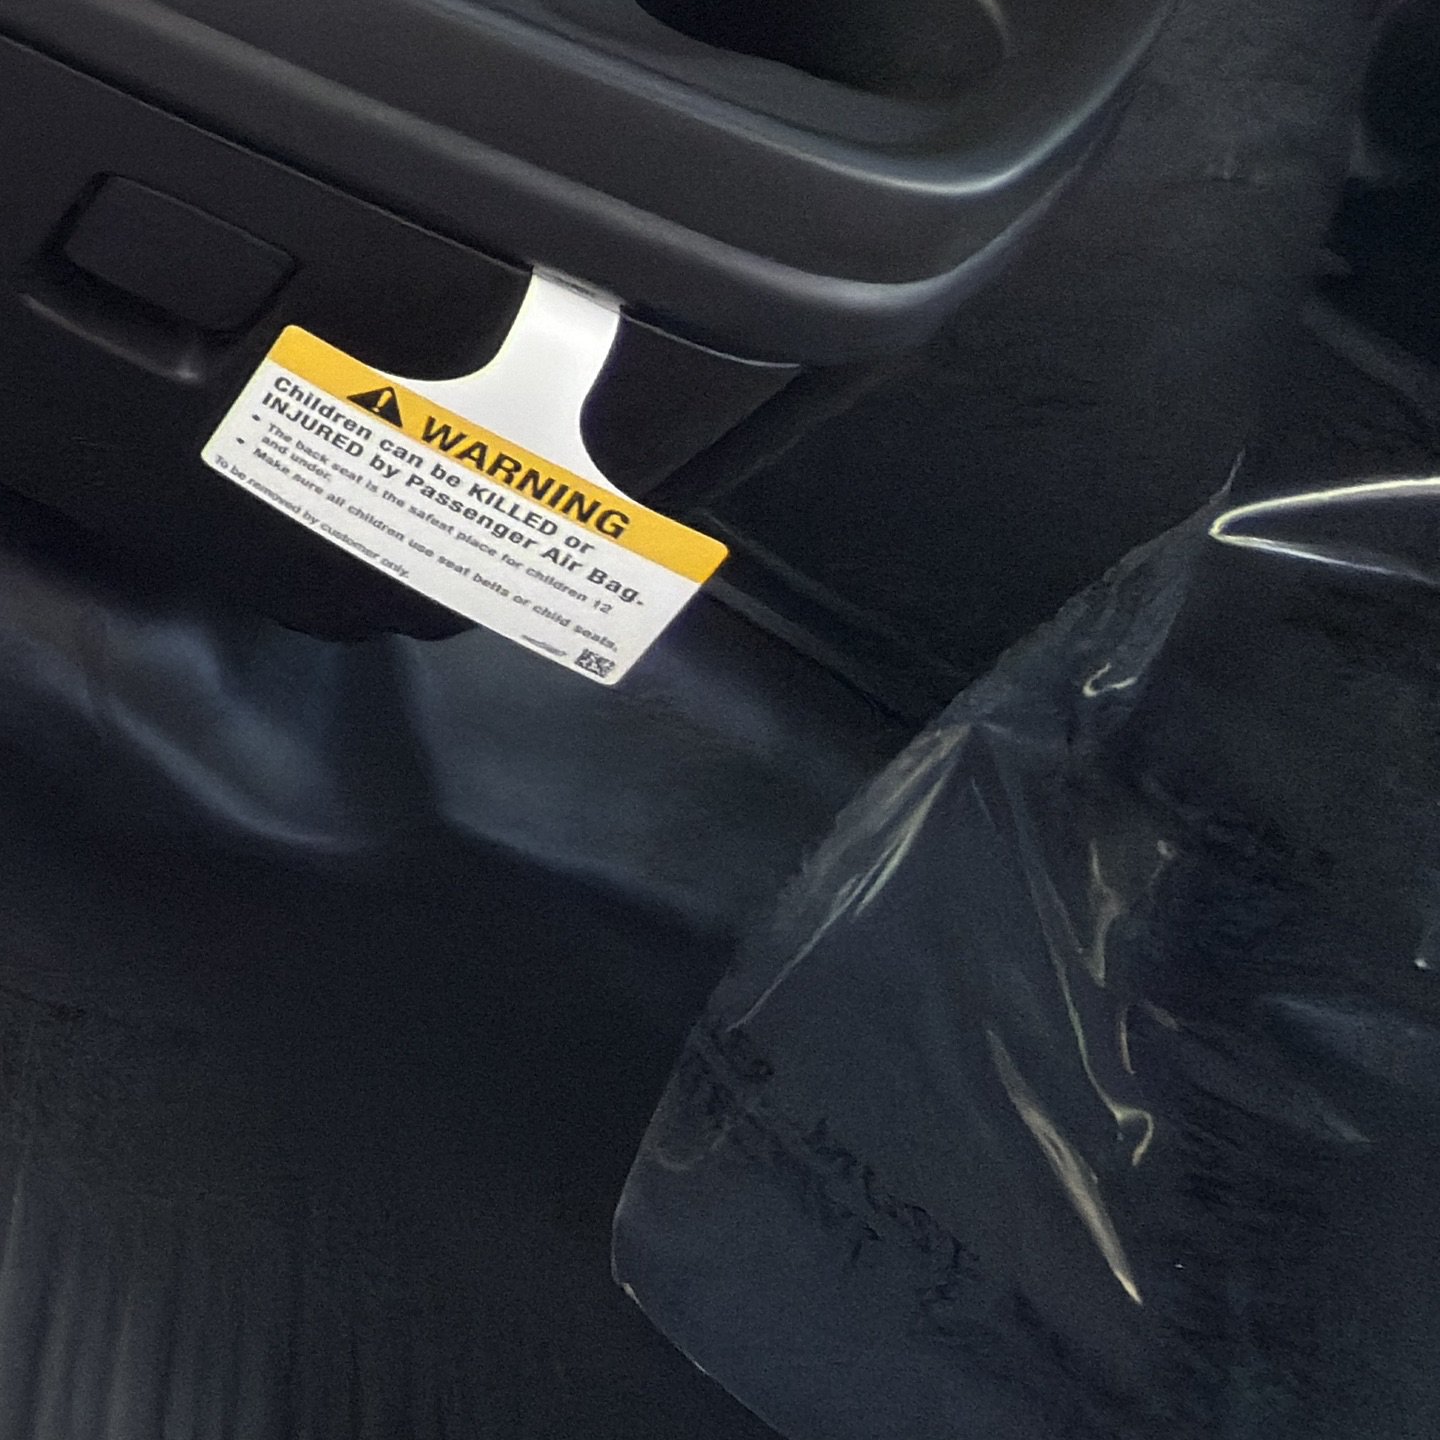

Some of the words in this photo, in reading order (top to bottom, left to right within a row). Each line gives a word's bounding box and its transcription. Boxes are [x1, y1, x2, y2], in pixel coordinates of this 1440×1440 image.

[216, 454, 229, 469] To
[229, 464, 247, 481] be
[247, 477, 302, 514] removed
[302, 510, 320, 525] by
[320, 523, 381, 559] customer
[261, 436, 289, 455] and
[262, 392, 364, 457] INJURED
[369, 454, 400, 479] by
[405, 474, 537, 549] Passenger
[541, 547, 583, 571] Air
[587, 567, 643, 605] Bag.
[268, 422, 293, 443] The
[294, 439, 328, 465] back
[331, 462, 364, 484] seat
[364, 480, 379, 493] is
[381, 489, 406, 508] the
[408, 505, 455, 534] safest
[455, 531, 498, 557] place
[500, 553, 523, 568] for
[525, 567, 588, 602] children
[592, 599, 613, 614] 12
[274, 377, 372, 440] Children
[379, 439, 424, 468] can
[430, 463, 461, 488] be
[468, 483, 558, 536] KILLED
[564, 536, 594, 553] or
[422, 417, 629, 539] WARNING
[252, 447, 291, 474] Make
[292, 473, 324, 495] sure
[326, 494, 346, 508] all
[347, 505, 406, 542] children
[407, 540, 435, 558] use
[438, 555, 471, 576] seat
[471, 572, 510, 598] belts
[512, 594, 530, 606] or
[531, 605, 572, 628] child
